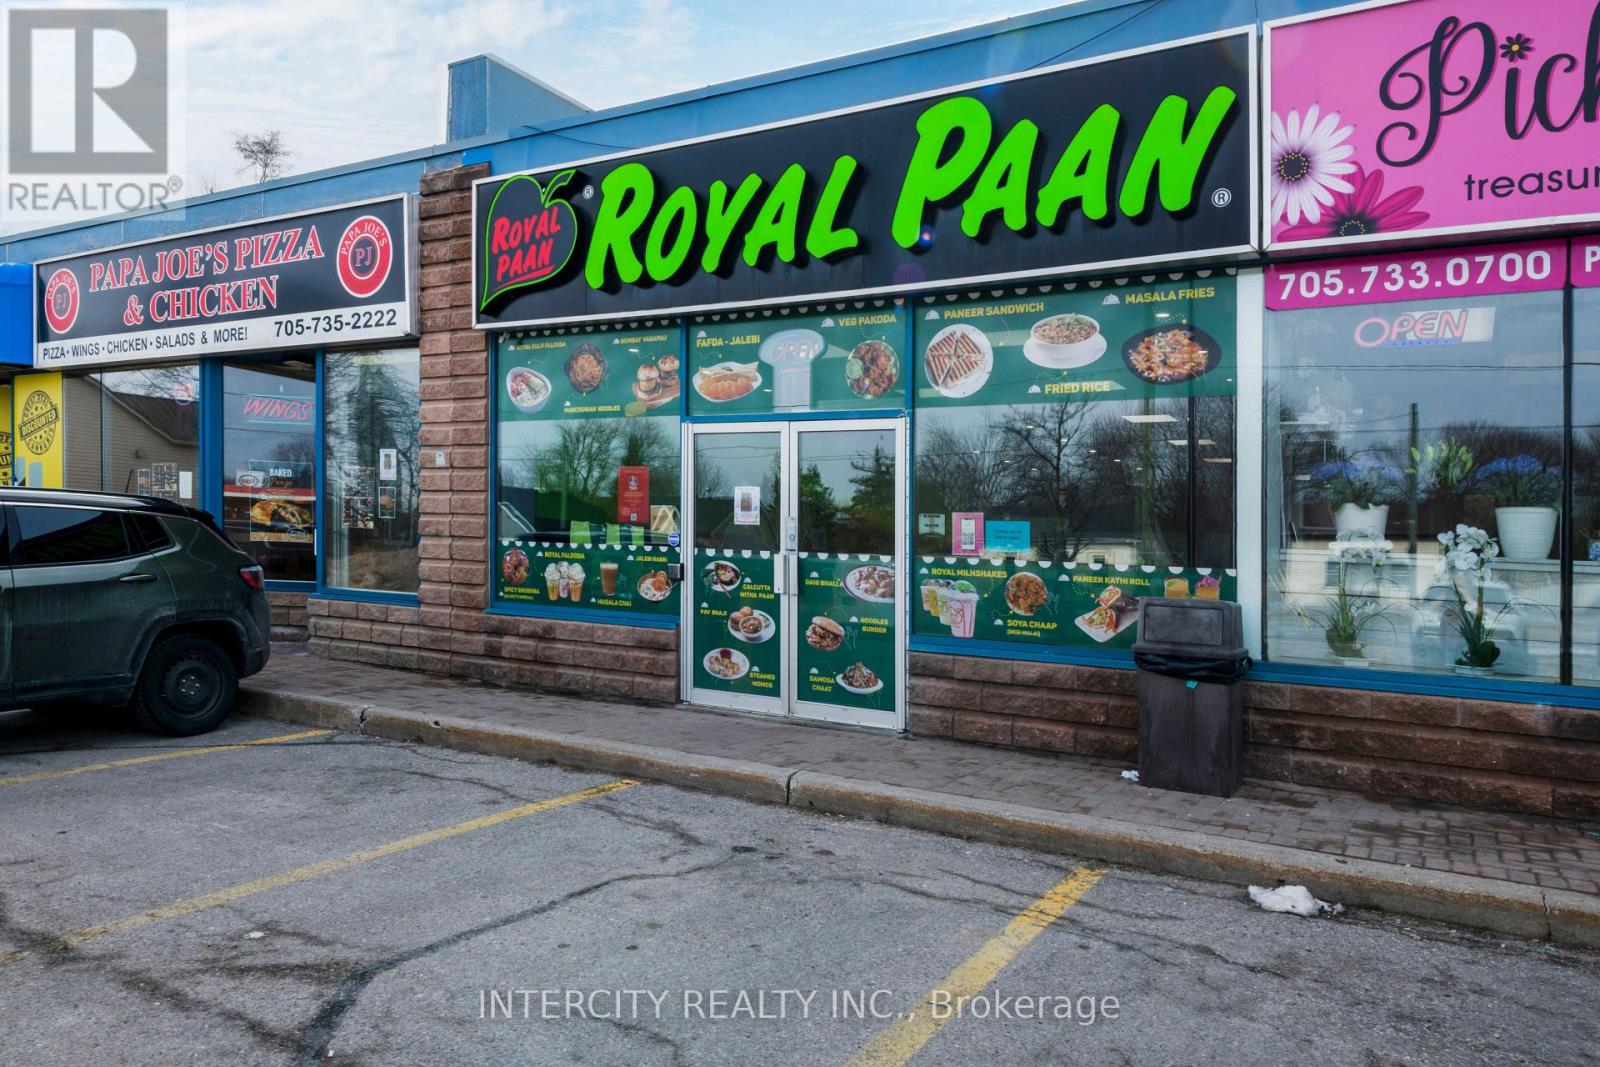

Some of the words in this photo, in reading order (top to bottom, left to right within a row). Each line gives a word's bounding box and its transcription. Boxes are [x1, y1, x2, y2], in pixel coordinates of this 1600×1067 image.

[584, 154, 858, 290] ROYAL
[891, 85, 1237, 249] PAAN
[492, 205, 561, 254] ROYAL
[341, 227, 360, 256] PAPA
[364, 222, 388, 247] JOE'S
[89, 255, 149, 292] PAPA
[152, 240, 229, 282] JOE'S
[234, 224, 325, 271] PIZZA
[355, 246, 373, 267] PJ
[497, 238, 553, 282] PAAN
[1279, 250, 1552, 300] 705.733.0700
[123, 294, 145, 326] &
[149, 275, 280, 322] CHICKEN
[1125, 291, 1177, 304] MASALA
[1178, 287, 1215, 300] FRIES
[943, 307, 985, 320] PANEER
[985, 301, 1045, 317] SANDWICH
[274, 308, 398, 338] 705-735-2222
[838, 317, 858, 327] VEG
[858, 314, 897, 326] PAKODA
[1354, 309, 1468, 347] OPEN
[43, 346, 66, 361] PIZZA
[71, 343, 100, 356] WINGS
[107, 337, 148, 354] CHICKEN
[155, 332, 195, 350] SALADS
[200, 331, 208, 345] &
[213, 326, 249, 343] MORE!
[696, 336, 724, 348] FAFDA
[730, 334, 761, 346] JALEBI
[1044, 382, 1081, 395] FRIED
[1082, 380, 1111, 393] RICE
[243, 397, 315, 421] WINGS
[20, 408, 57, 437] DISCOUNTED
[269, 467, 293, 478] BAKED
[931, 567, 956, 577] ROYAL
[1072, 575, 1104, 584] PANEER
[1104, 576, 1129, 585] KATHI
[1129, 578, 1151, 586] ROLL
[742, 583, 771, 592] CALCUTTA
[597, 599, 618, 607] MASALA
[618, 599, 632, 607] CHAI
[860, 617, 889, 626] NOODLES
[862, 625, 888, 634] BURGER
[1007, 619, 1028, 628] SOYA
[1028, 620, 1058, 630] CHAAP
[750, 672, 776, 681] STEAMED
[809, 675, 836, 684] SAMOSA
[812, 684, 833, 693] CHAAT
